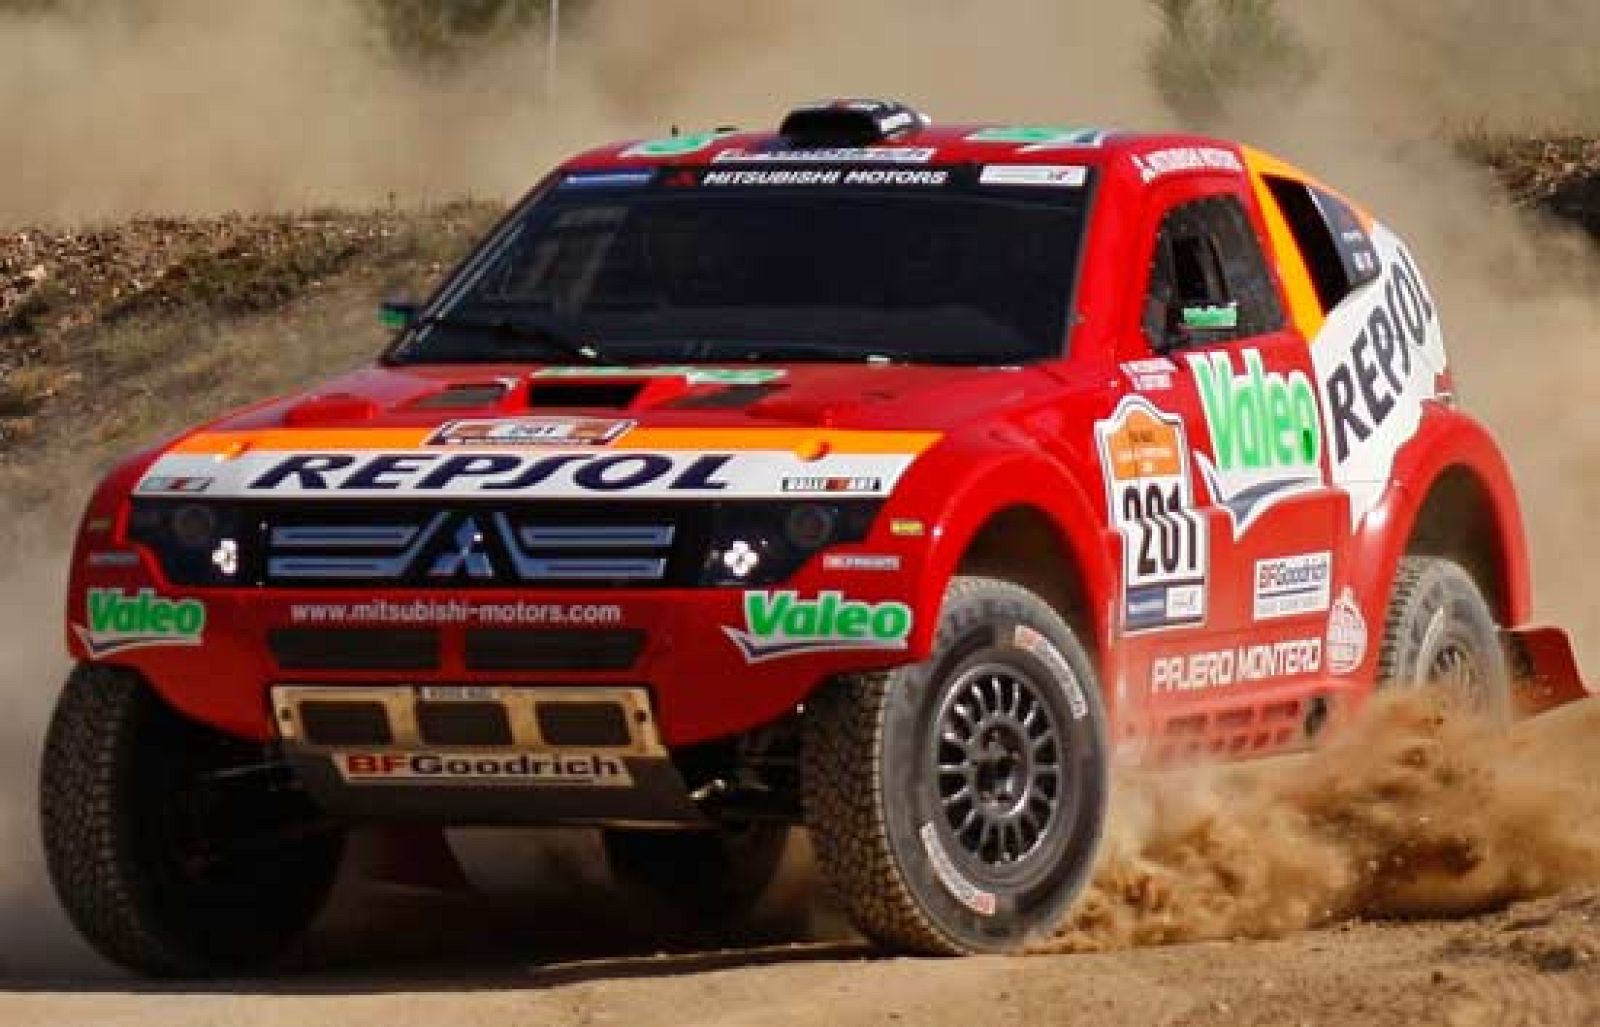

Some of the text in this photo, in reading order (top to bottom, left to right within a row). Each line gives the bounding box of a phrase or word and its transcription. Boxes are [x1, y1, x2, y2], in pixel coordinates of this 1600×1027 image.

[703, 170, 949, 186] MITSUBISHI MOTORS
[1326, 247, 1433, 463] REPSOL
[1190, 350, 1320, 469] Valeo
[248, 455, 734, 490] REPSOL
[1122, 483, 1198, 577] 201
[89, 588, 206, 635] Valeo
[290, 599, 622, 622] www.mitsubishi-motors.com
[746, 591, 911, 640] Valeo
[1238, 637, 1322, 682] MONTERO
[346, 753, 620, 777] BFGoodrich
